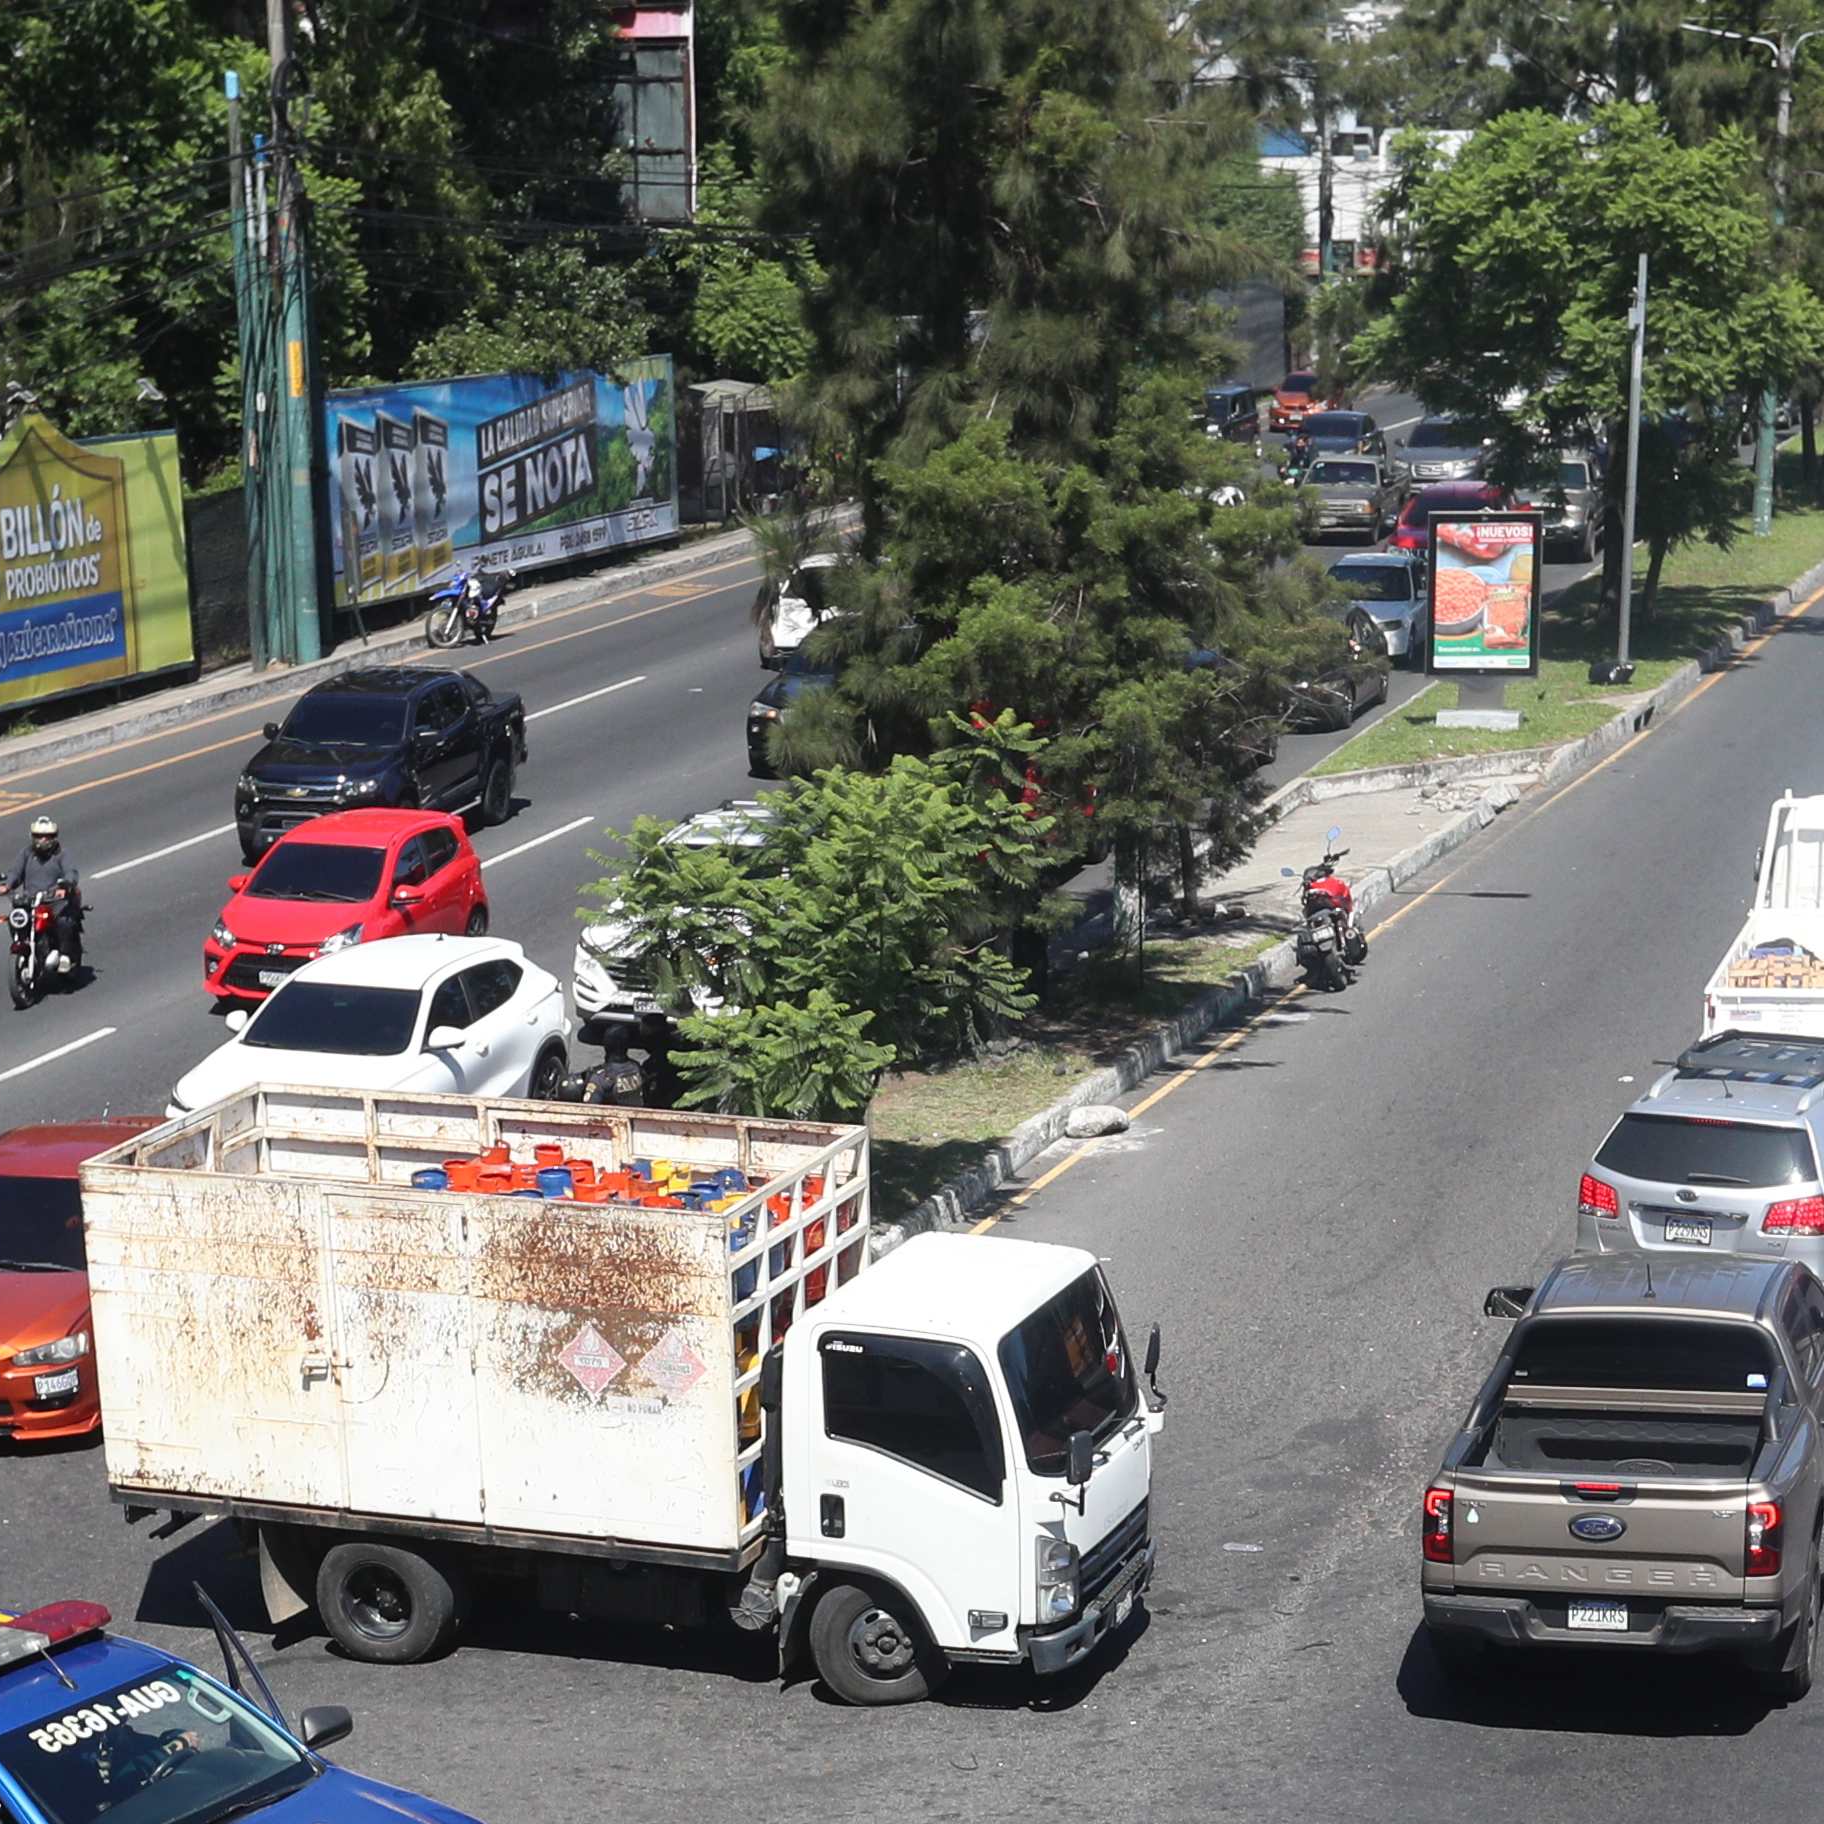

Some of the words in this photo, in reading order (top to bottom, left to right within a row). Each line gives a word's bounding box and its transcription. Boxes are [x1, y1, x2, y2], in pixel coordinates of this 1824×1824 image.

[0, 483, 84, 560] BILLÓN
[85, 513, 102, 543] de
[483, 465, 518, 534] SE
[525, 434, 593, 515] NOTA
[1479, 1560, 1717, 1588] RANGER
